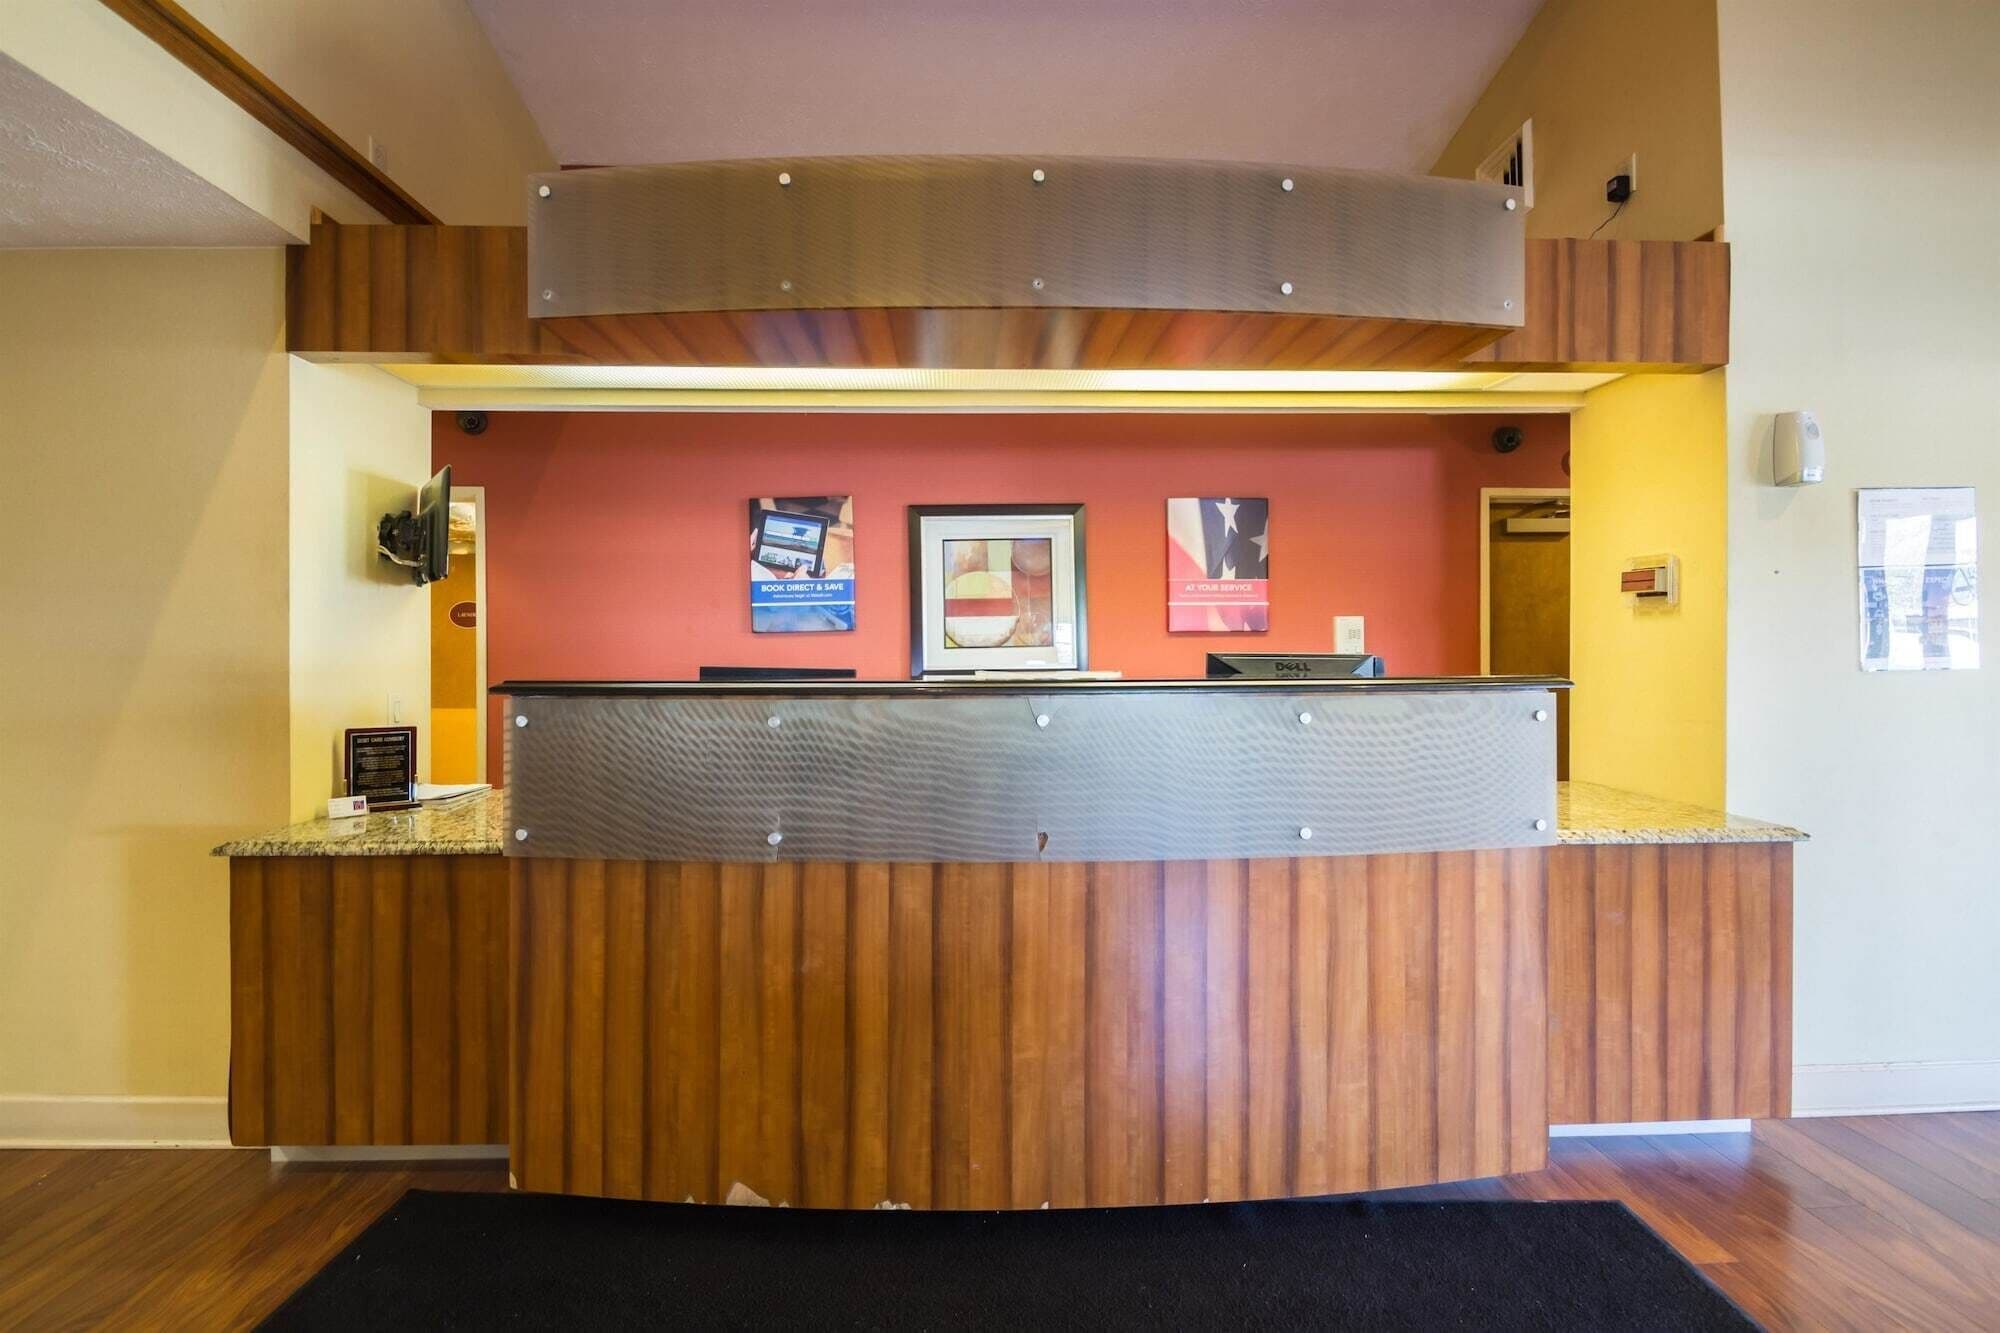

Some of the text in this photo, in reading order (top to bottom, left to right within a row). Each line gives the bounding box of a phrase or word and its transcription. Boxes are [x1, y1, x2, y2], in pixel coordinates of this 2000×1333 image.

[761, 583, 844, 592] BOOK DIRECT & SAVE
[1185, 583, 1253, 592] AT YOUR SERVICE
[1275, 662, 1312, 671] DELL
